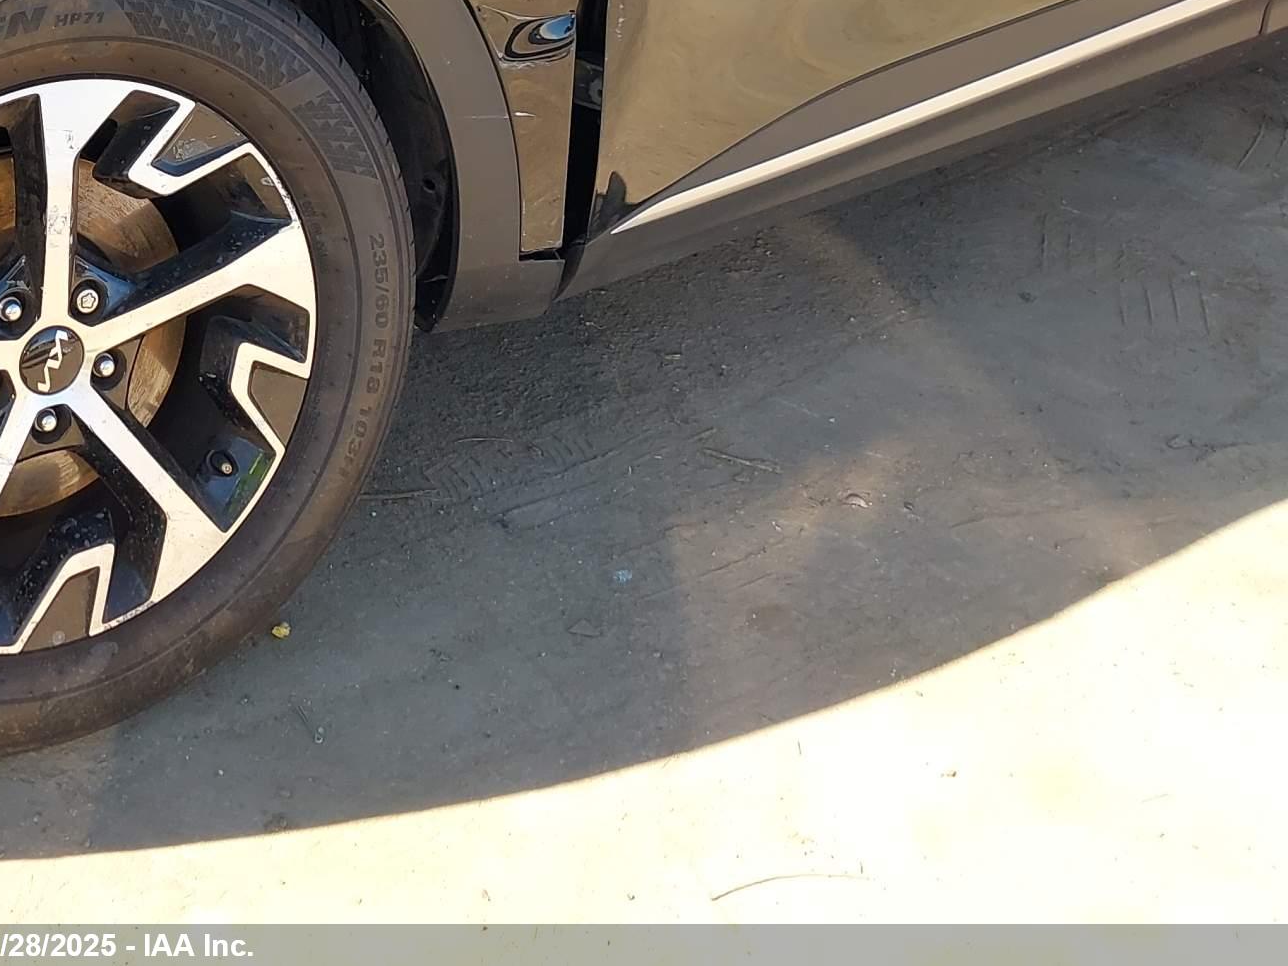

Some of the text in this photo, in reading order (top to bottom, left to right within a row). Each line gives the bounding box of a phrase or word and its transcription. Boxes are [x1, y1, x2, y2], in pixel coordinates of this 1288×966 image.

[53, 11, 105, 30] HP71
[368, 233, 390, 329] 235/60
[366, 338, 387, 395] R18
